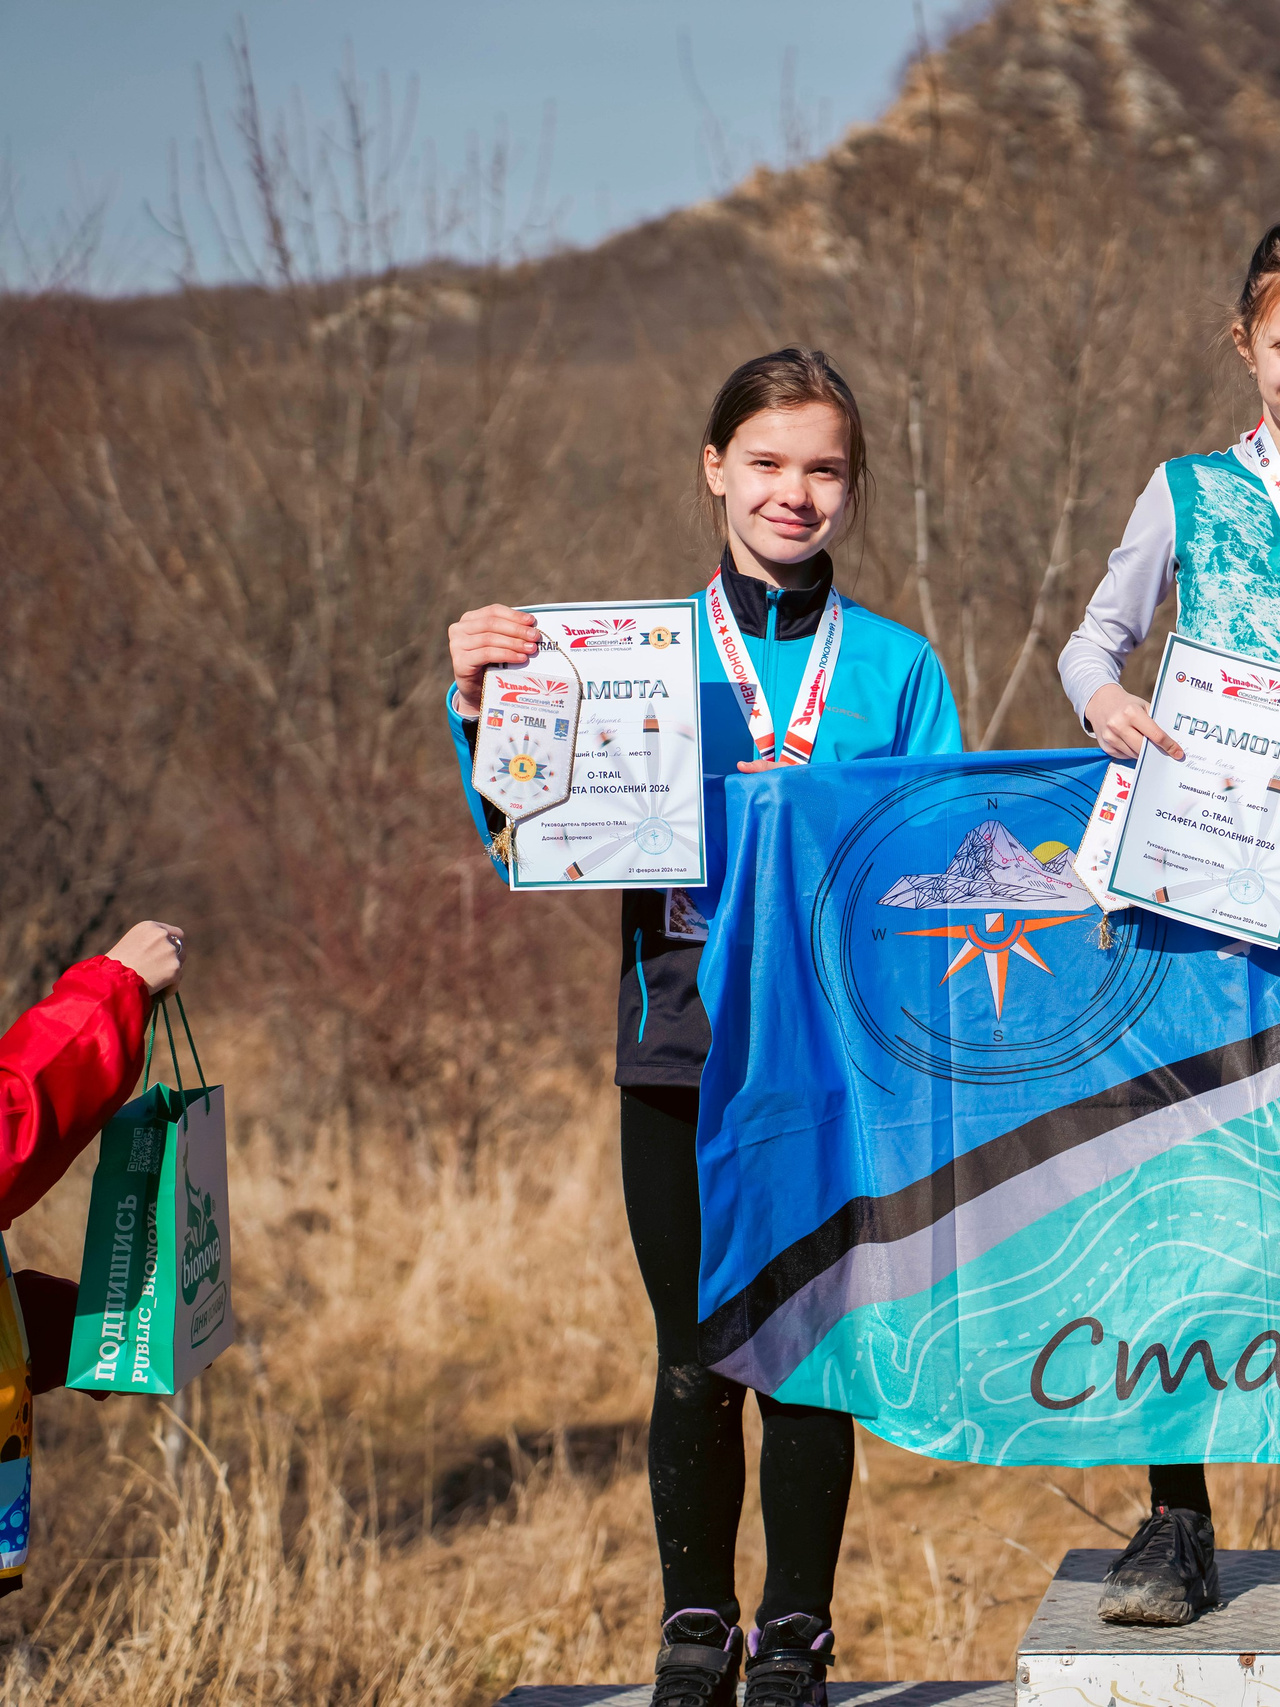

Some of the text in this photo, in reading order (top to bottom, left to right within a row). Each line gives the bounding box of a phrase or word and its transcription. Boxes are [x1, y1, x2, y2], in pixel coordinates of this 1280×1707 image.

[562, 624, 609, 636] Эстафета
[536, 641, 559, 651] TRAIL
[710, 596, 757, 706] ЛЕРМОНТОВ 2026
[791, 623, 837, 727] Эстафета ПОКОЛЕНИЙ
[1175, 671, 1214, 692] O-TRAIL
[1220, 669, 1262, 690] Эстафета
[496, 676, 540, 693] Эстафета
[584, 679, 669, 700] МОТА
[519, 696, 551, 705] ПОКОЛЕНИЙ
[1238, 691, 1269, 703] ПОКОЛЕНИЙ
[587, 771, 622, 780] O-TRAIL
[590, 783, 647, 794] ПОКОЛЕНИЙ
[649, 784, 670, 793] 2026
[987, 798, 999, 811] N
[1178, 781, 1211, 797] Занявший
[1246, 803, 1269, 813] место
[509, 802, 523, 810] 2026
[1201, 809, 1234, 825] O-TRAIL
[564, 834, 593, 842] Харченко
[1155, 809, 1276, 851] ЭСТАФЕТА ПОКОЛЕНИЙ 2026
[1143, 853, 1189, 872] Данила Харченко
[1146, 840, 1225, 869] Руководитель проекта O-TRAIL
[636, 866, 660, 874] февраля
[1218, 910, 1242, 921] февраля
[1242, 916, 1254, 925] 2026
[872, 927, 888, 941] W
[993, 1029, 1004, 1042] S
[183, 1237, 221, 1289] bionova
[94, 1194, 138, 1382] ПОДПИШИСЬ
[131, 1201, 158, 1384] PUBLIC_BIONOVA
[193, 1292, 224, 1338] ДНЯ ОСНОВА
